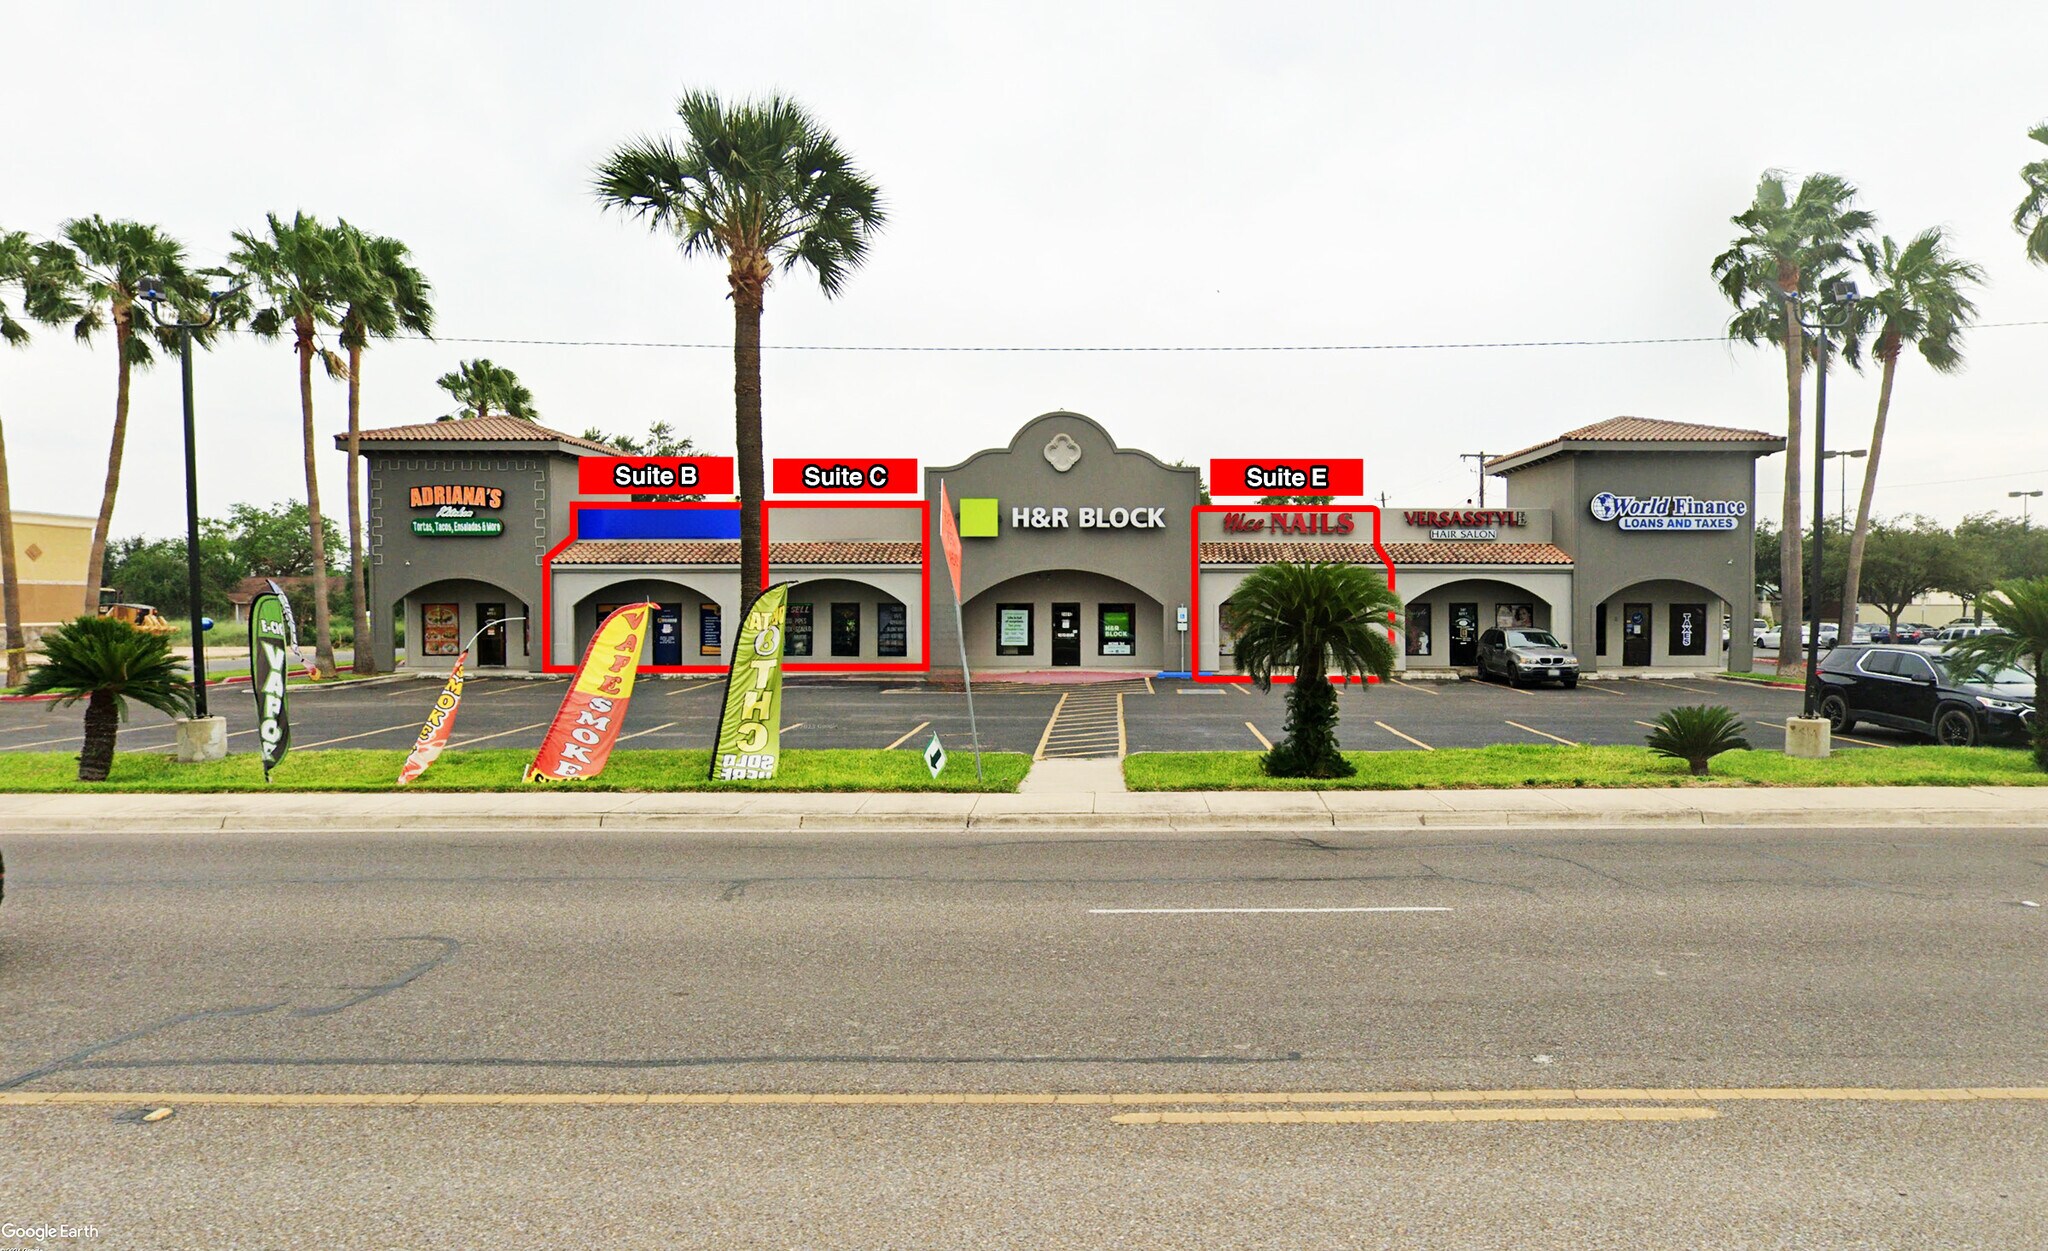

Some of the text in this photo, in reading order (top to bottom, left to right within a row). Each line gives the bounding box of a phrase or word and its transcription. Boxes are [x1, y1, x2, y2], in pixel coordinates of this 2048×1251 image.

[410, 485, 502, 508] ADRIANA'S
[1613, 497, 1746, 515] World Finance
[1012, 507, 1166, 528] H&R BLOCK
[1223, 512, 1355, 535] Nice NAILS
[1624, 519, 1733, 528] LOANS AND TAXES
[1431, 530, 1496, 538] HAIR SALON
[1682, 613, 1692, 646] TAXES
[597, 610, 646, 695] VAPE
[420, 664, 465, 741] SMOKE
[553, 697, 613, 777] SMOKE
